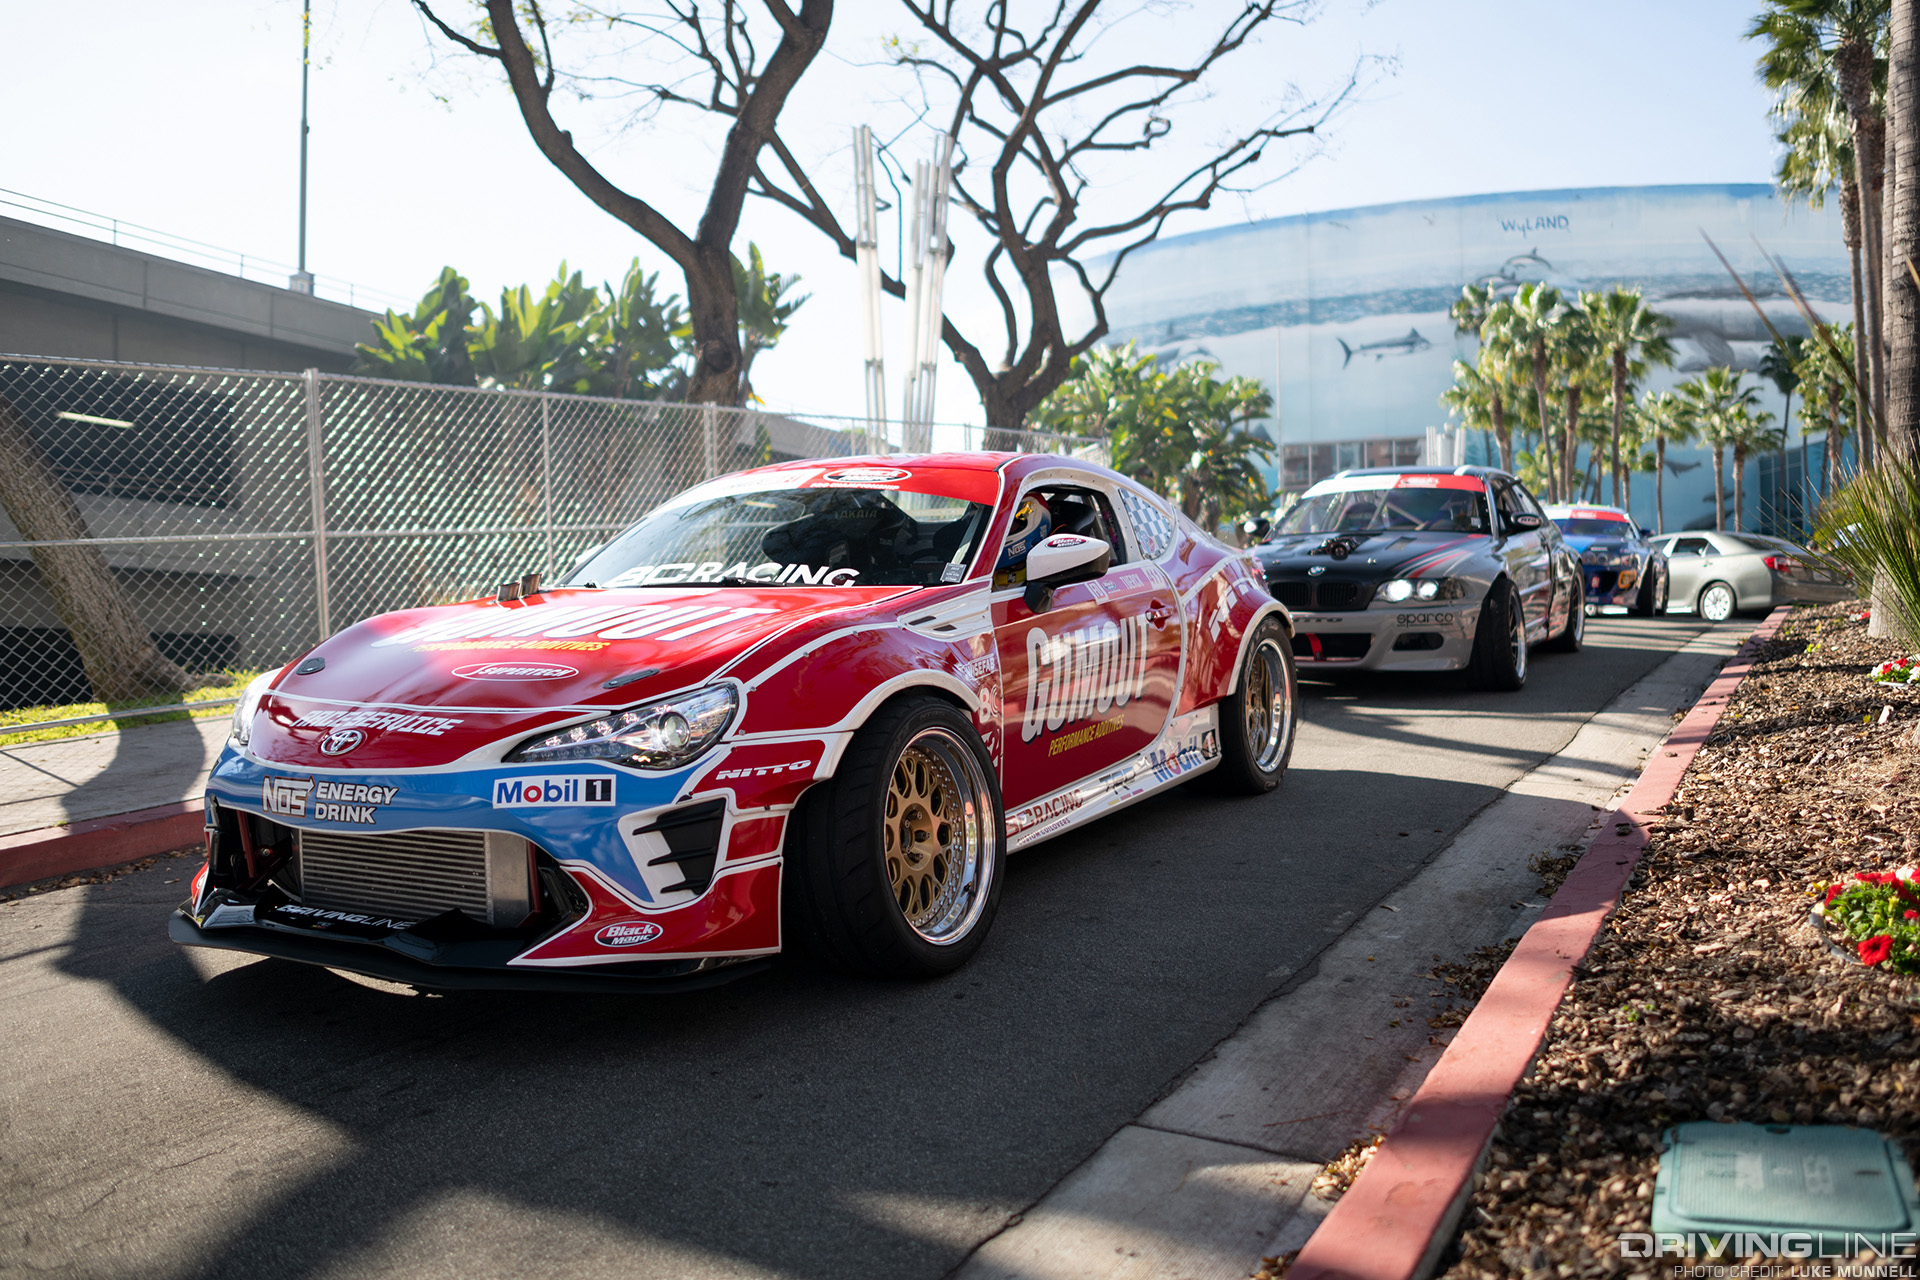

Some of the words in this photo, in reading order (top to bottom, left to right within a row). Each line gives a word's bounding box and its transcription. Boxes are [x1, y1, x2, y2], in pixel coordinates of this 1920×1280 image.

[1021, 614, 1150, 744] GUMOUT
[1047, 724, 1097, 757] PERFORMANCE
[1094, 714, 1125, 740] ADDITIVES
[715, 760, 812, 781] NITTO
[262, 774, 316, 818] NOS
[315, 781, 399, 805] ENERGY
[496, 779, 579, 804] Mobil
[314, 803, 376, 824] DRINK
[605, 924, 655, 938] Black
